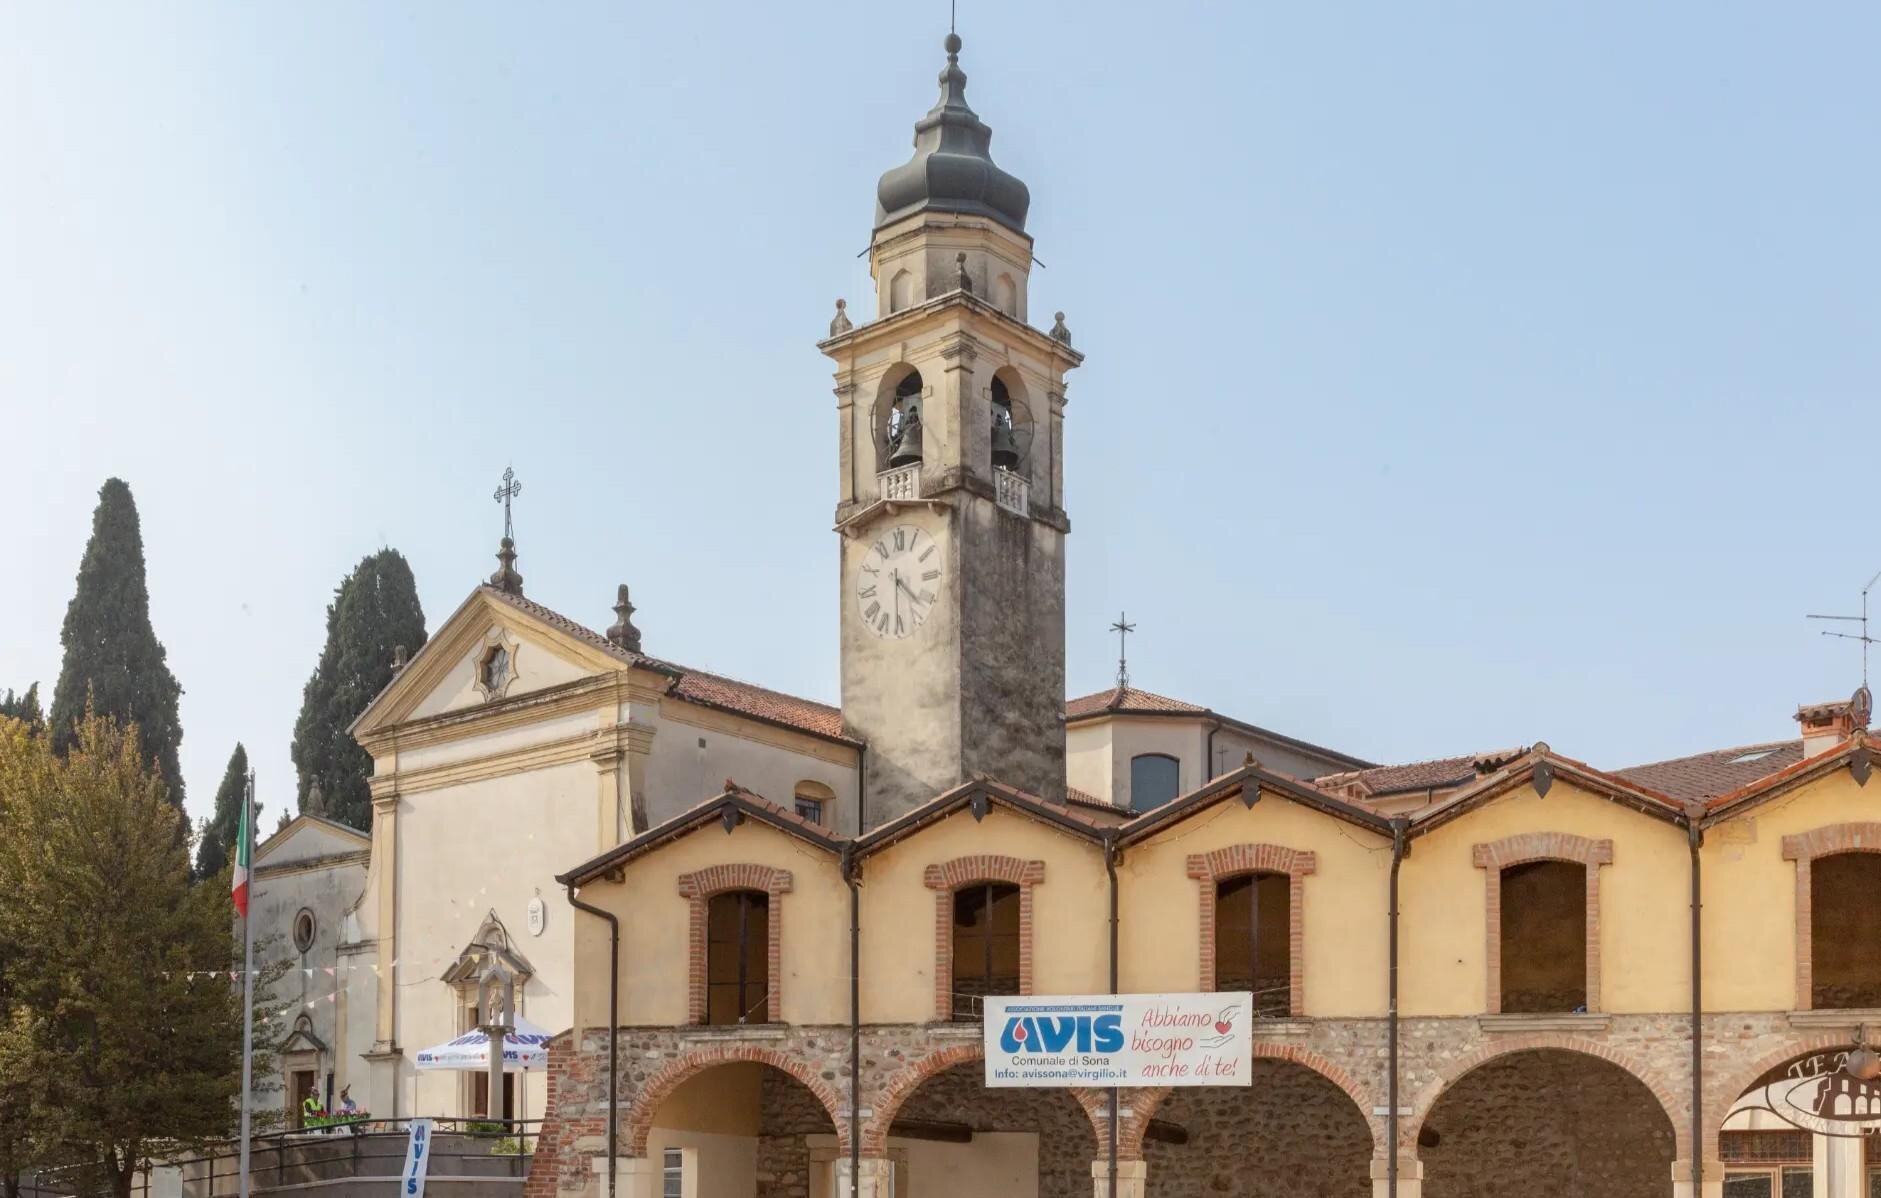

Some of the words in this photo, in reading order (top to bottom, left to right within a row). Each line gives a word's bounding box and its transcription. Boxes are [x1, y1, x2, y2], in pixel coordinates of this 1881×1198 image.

[1141, 1004, 1212, 1028] Abbiamo
[1000, 1014, 1125, 1053] AVIS
[1131, 1029, 1194, 1059] bisogno
[502, 1051, 518, 1059] VIS
[1011, 1056, 1065, 1066] Comunale
[1069, 1055, 1079, 1066] di
[1082, 1056, 1110, 1066] Sona
[1141, 1053, 1189, 1078] anche
[1195, 1054, 1212, 1077] di
[1215, 1056, 1239, 1077] te!
[995, 1067, 1019, 1079] Info:
[1022, 1067, 1127, 1080] avissona@virgilio.it
[407, 1124, 425, 1195] AVIS
